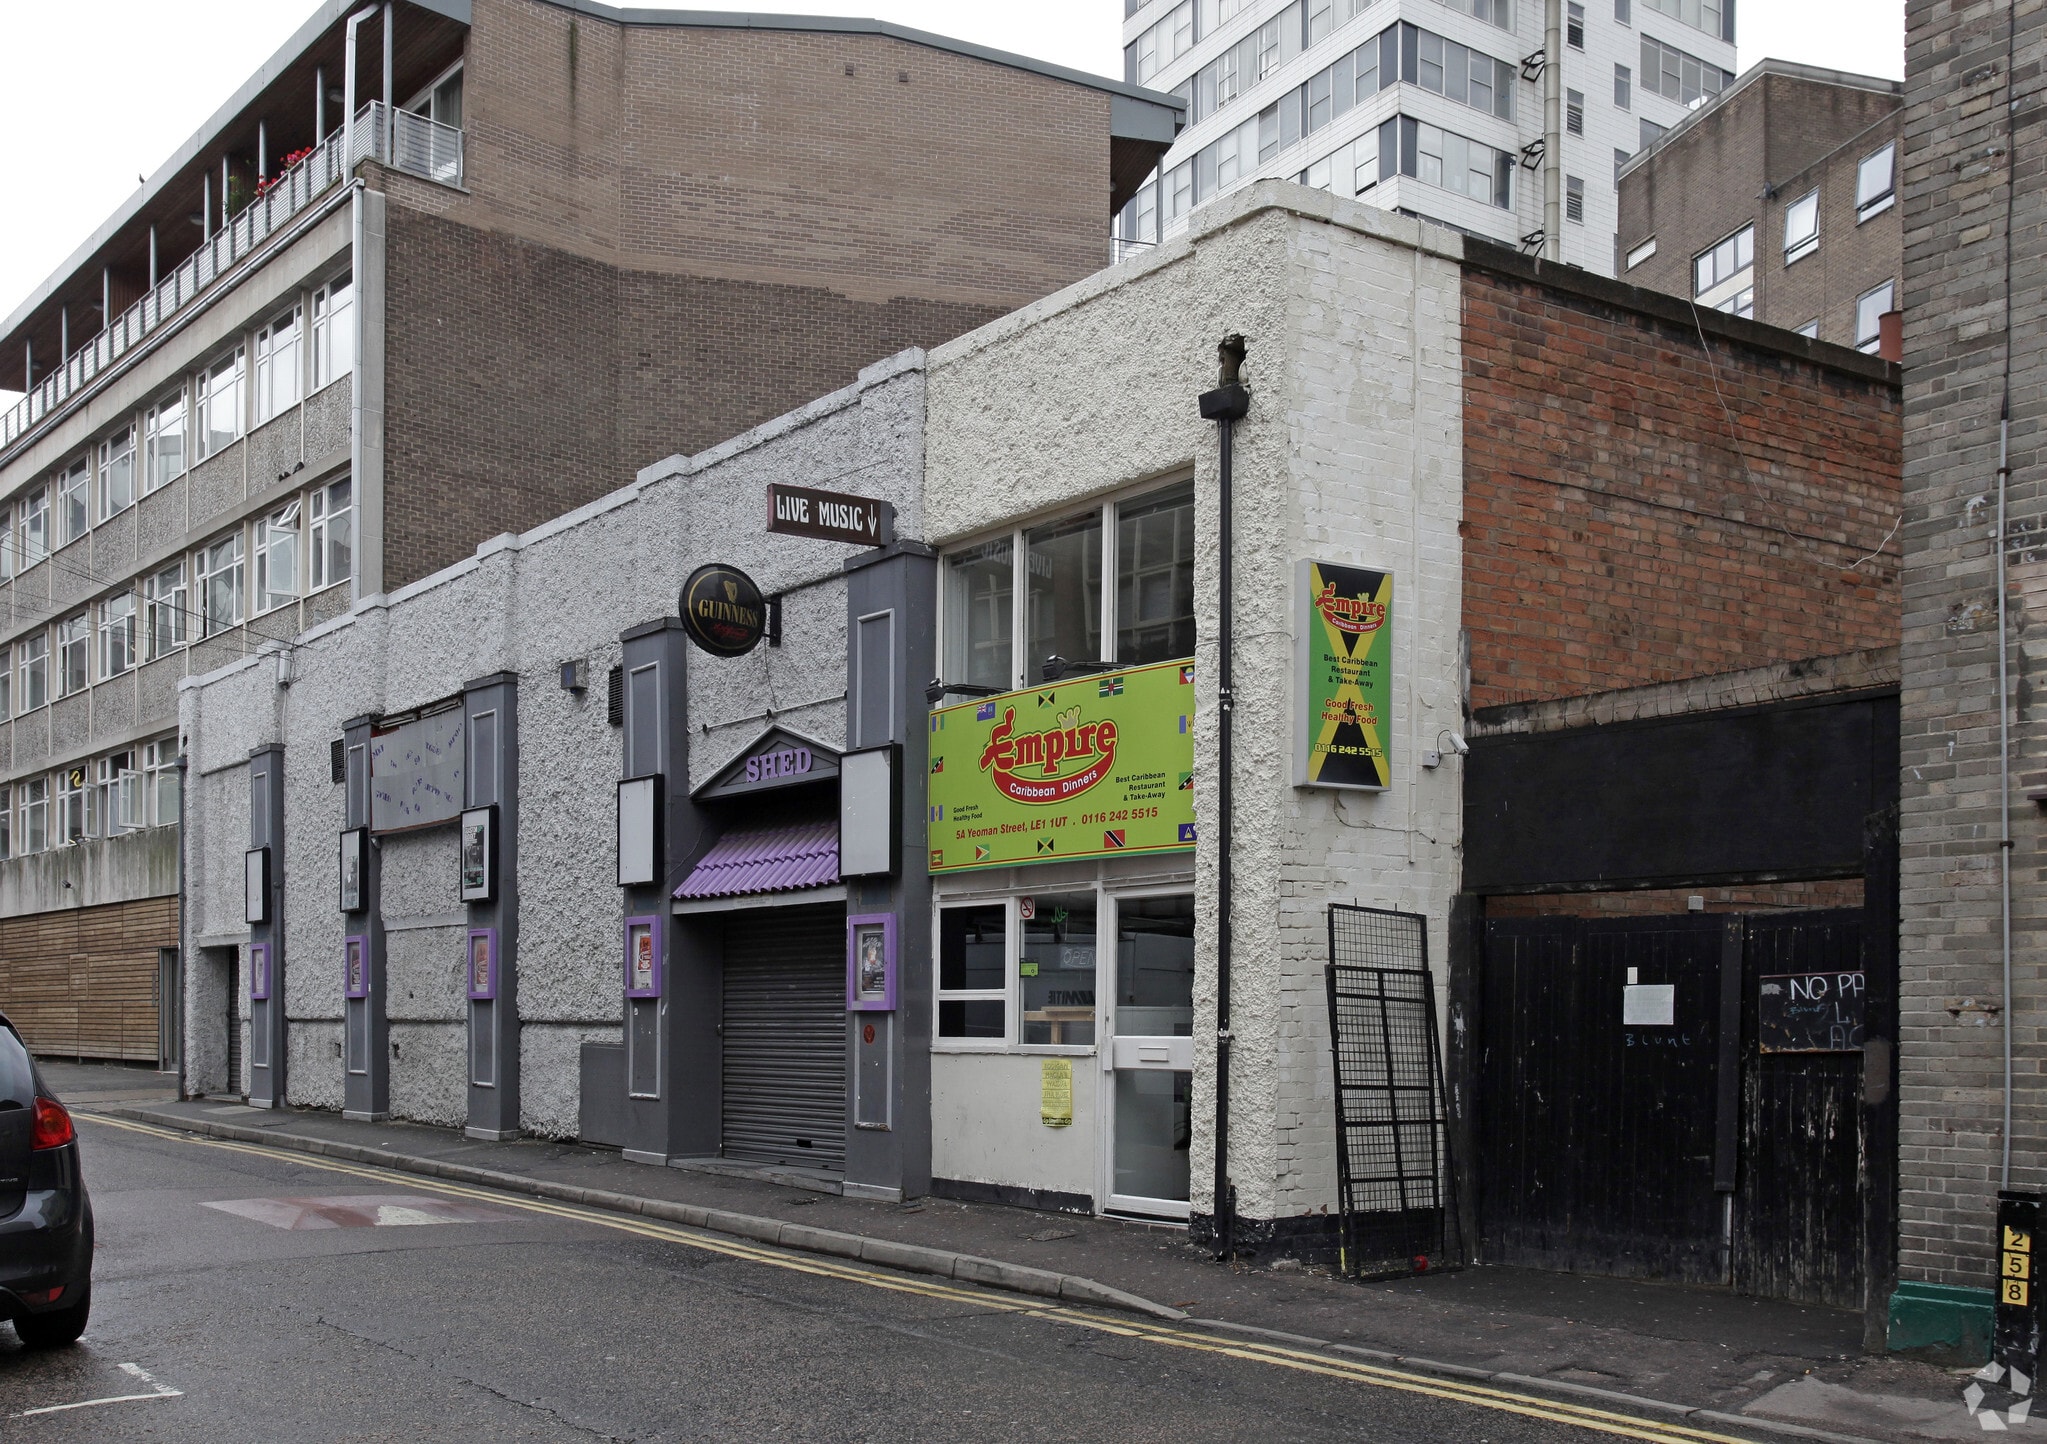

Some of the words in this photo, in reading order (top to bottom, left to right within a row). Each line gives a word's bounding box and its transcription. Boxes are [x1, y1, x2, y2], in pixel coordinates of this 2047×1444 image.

[776, 494, 810, 524] LIVE
[819, 500, 863, 532] MUSIC
[1315, 582, 1387, 620] Empire
[698, 599, 758, 628] GUINNESS
[1331, 617, 1358, 631] Caribbean
[1359, 622, 1377, 632] Dinners
[1323, 653, 1341, 663] Best
[1341, 656, 1379, 668] Caribbean
[1330, 665, 1371, 677] Restaurant
[1327, 675, 1334, 683] &
[1335, 677, 1374, 689] Take-Away
[1324, 698, 1348, 710] Good
[1349, 700, 1374, 712] Fresh
[1321, 711, 1355, 725] Healthy
[1356, 715, 1378, 726] Food
[979, 705, 1119, 776] Empire
[1314, 743, 1337, 754] 0116
[1338, 745, 1358, 755] 242
[1359, 746, 1383, 758] 5515
[745, 747, 812, 783] SHED
[1009, 782, 1056, 798] Caribbean
[1062, 769, 1098, 794] Dinners
[1115, 775, 1130, 784] Best
[1131, 771, 1166, 782] Caribbean
[1128, 781, 1166, 792] Restaurant
[1130, 791, 1166, 802] Take-Away
[953, 806, 965, 814] Good
[965, 804, 979, 812] Fresh
[953, 814, 971, 822] Healthy
[972, 812, 983, 820] Food
[956, 830, 966, 840] 5A
[967, 827, 999, 839] Yeoman
[1000, 822, 1028, 835] Street,
[1030, 819, 1047, 831] LE1
[1050, 816, 1068, 829] 1UT
[1081, 812, 1106, 825] 0116
[1109, 810, 1128, 822] 242
[1131, 807, 1158, 820] 5515
[1790, 976, 1827, 1000] NO
[1625, 1033, 1691, 1047] Blunt
